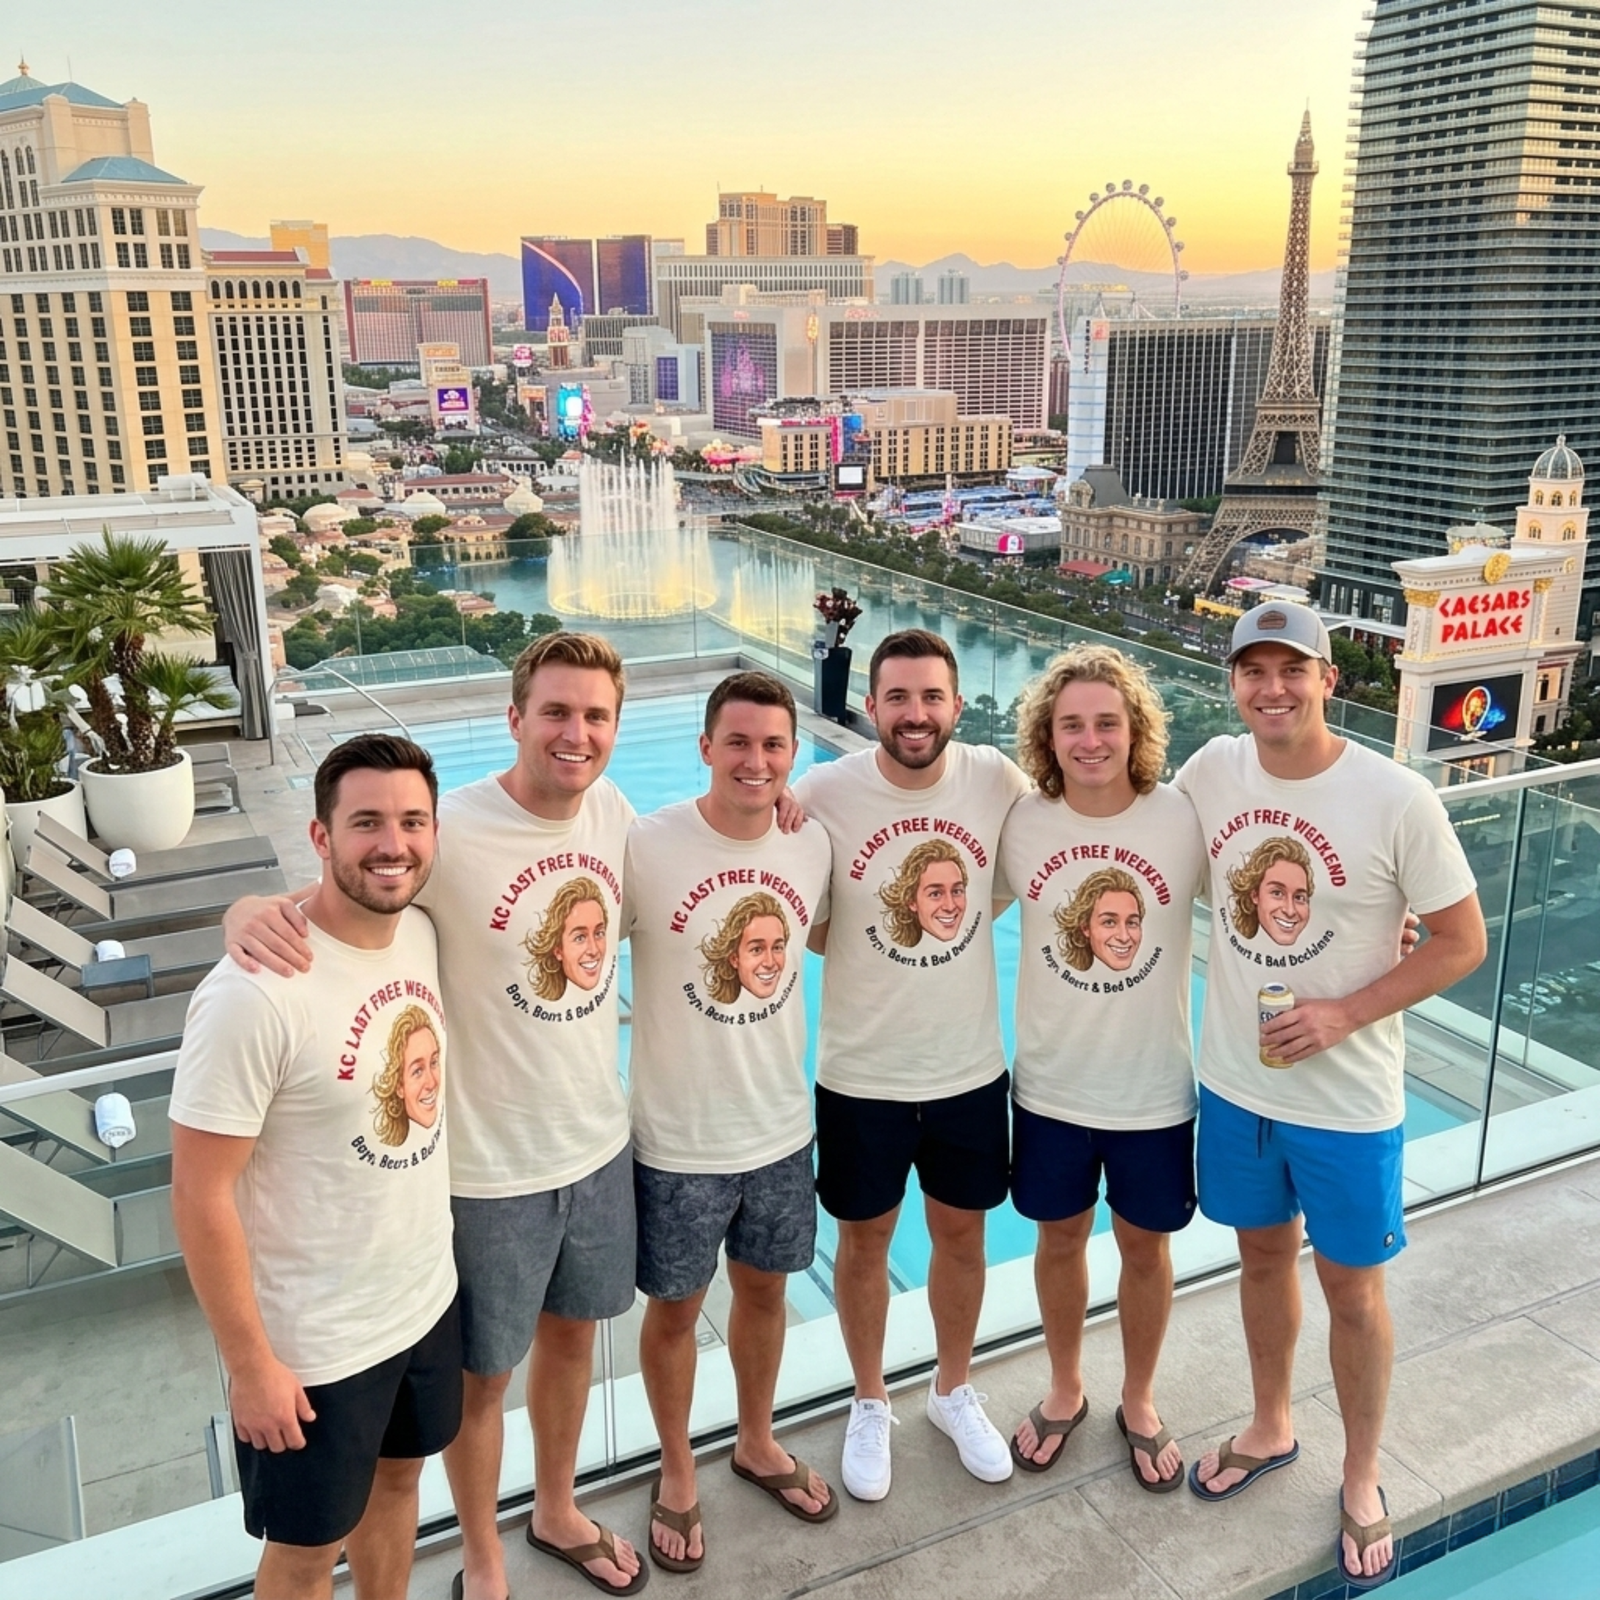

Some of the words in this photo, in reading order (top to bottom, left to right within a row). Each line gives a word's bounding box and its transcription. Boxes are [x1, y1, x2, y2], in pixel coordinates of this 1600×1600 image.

[1439, 589, 1531, 617] CAESARS
[1441, 615, 1523, 643] PALACE
[892, 817, 929, 836] FREE
[1037, 851, 1068, 881] LAST
[1071, 845, 1110, 860] FREE
[1254, 809, 1292, 827] FREE
[1293, 817, 1346, 887] WEEKEND
[489, 906, 510, 931] KC
[501, 867, 537, 905] LAST
[537, 853, 574, 876] FREE
[682, 878, 715, 911] LAST
[717, 869, 755, 887] FREE
[1091, 982, 1100, 993] &
[337, 1054, 356, 1080] KC
[370, 981, 402, 1011] FREE
[411, 1153, 420, 1166] &
